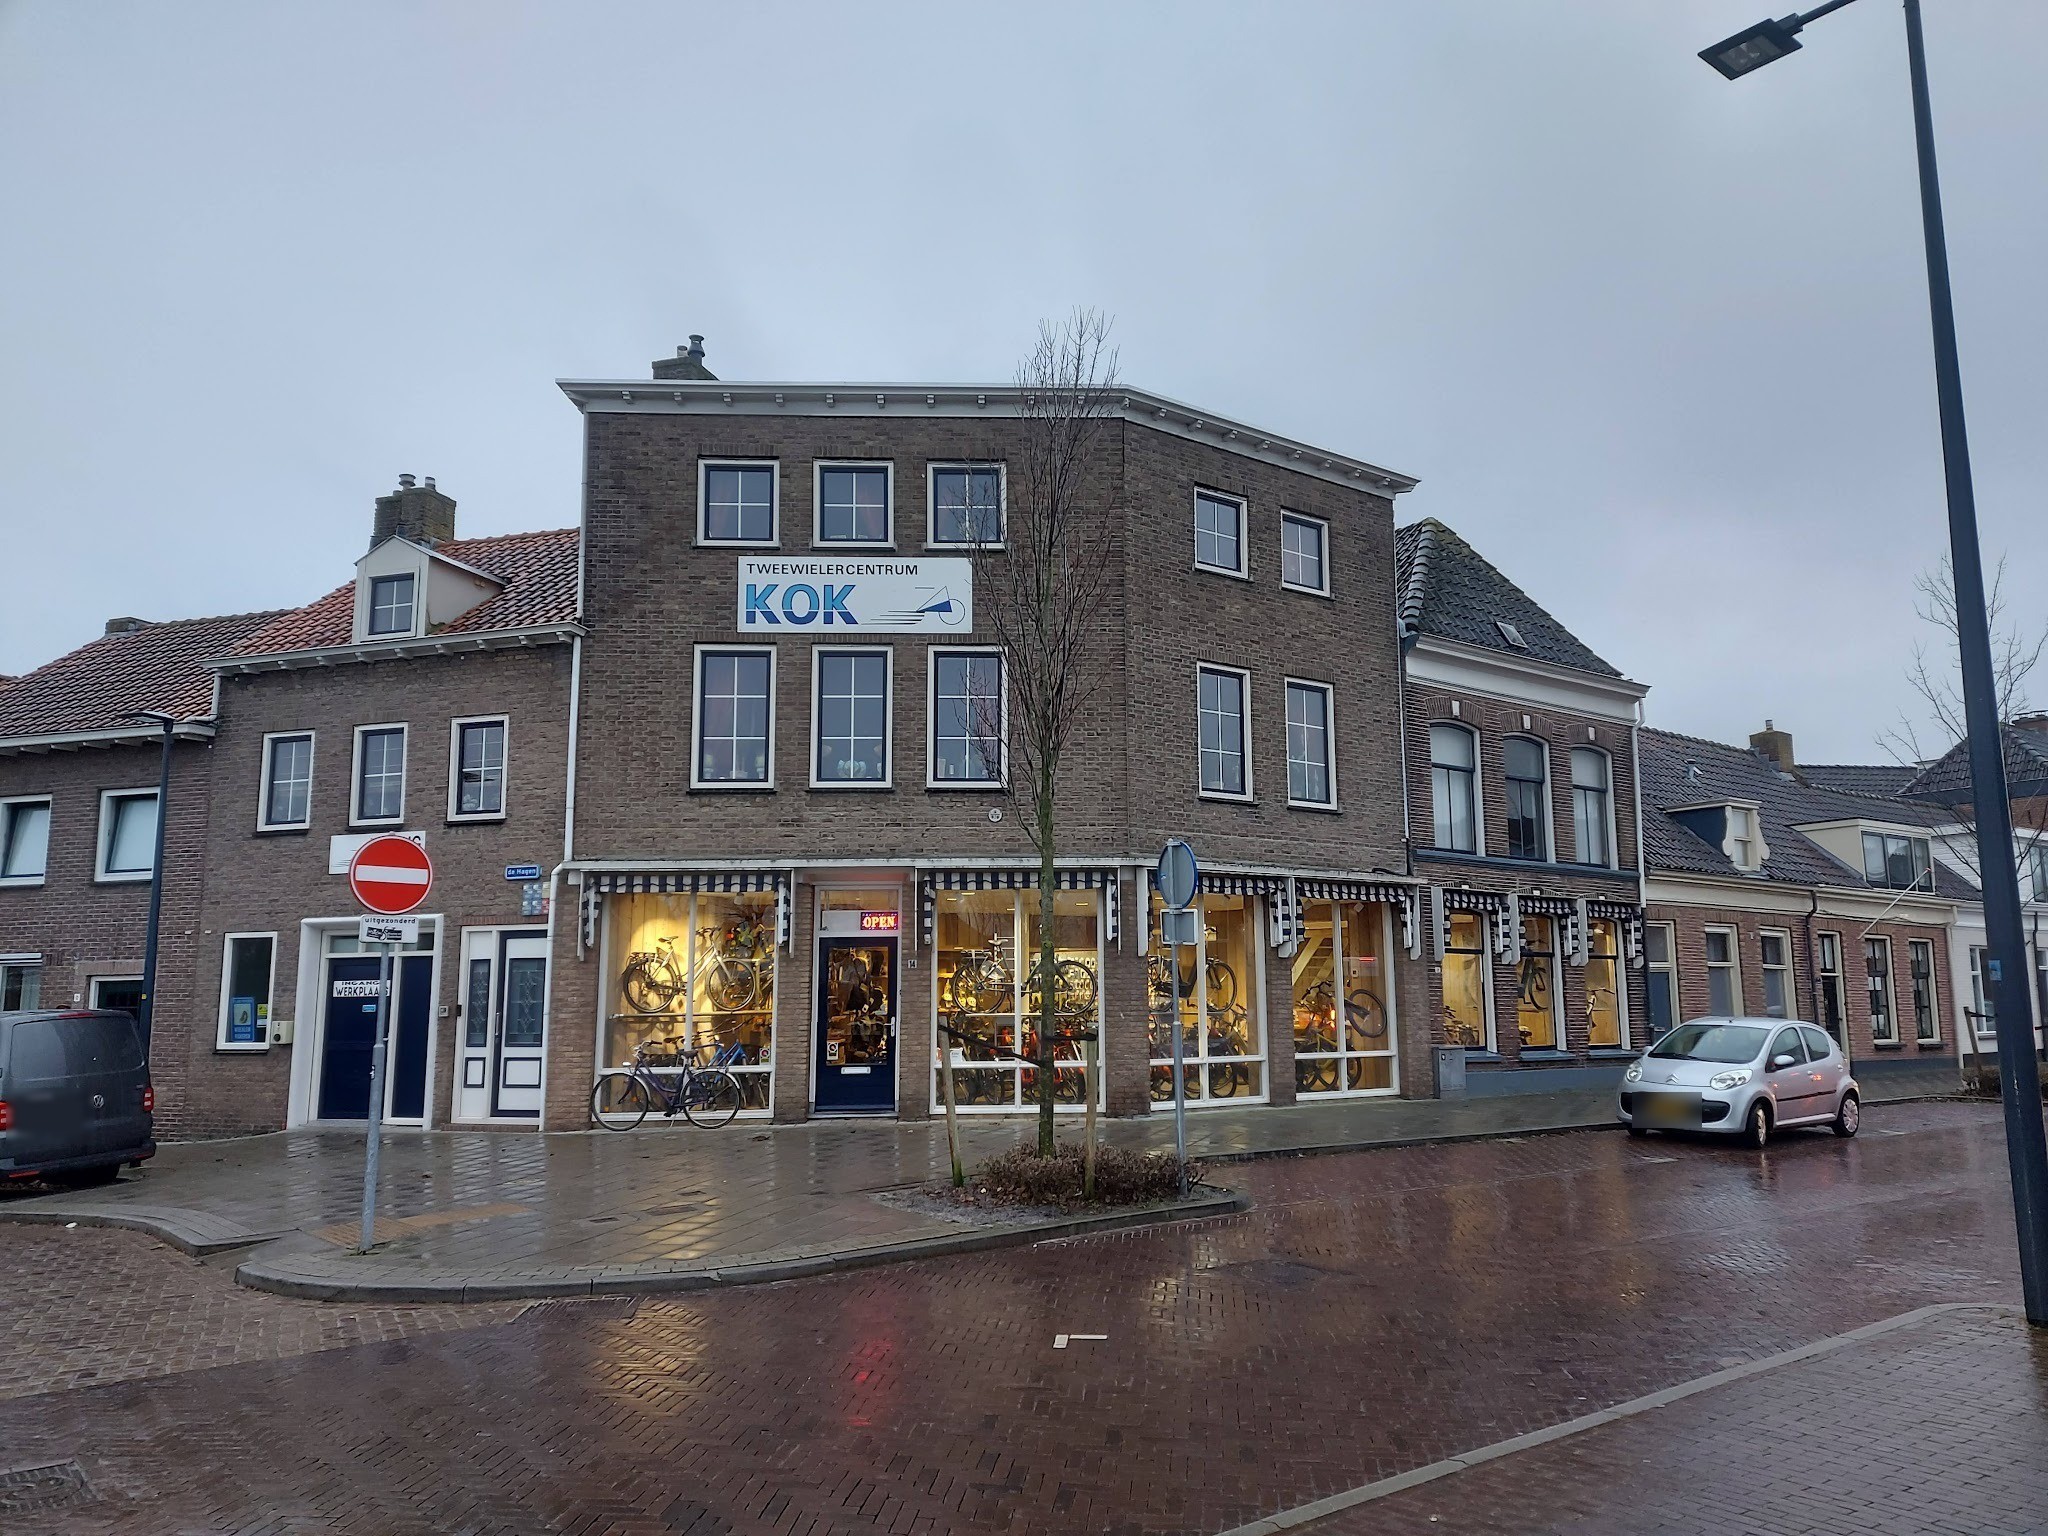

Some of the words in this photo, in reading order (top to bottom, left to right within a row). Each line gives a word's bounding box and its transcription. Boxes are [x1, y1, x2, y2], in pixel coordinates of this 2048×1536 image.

[746, 563, 918, 575] TWEEWIELERCENTRUM
[745, 583, 858, 625] KOK
[364, 917, 416, 925] uitgezonderd
[863, 916, 895, 928] OPEN
[335, 986, 389, 997] WERKPLAAS
